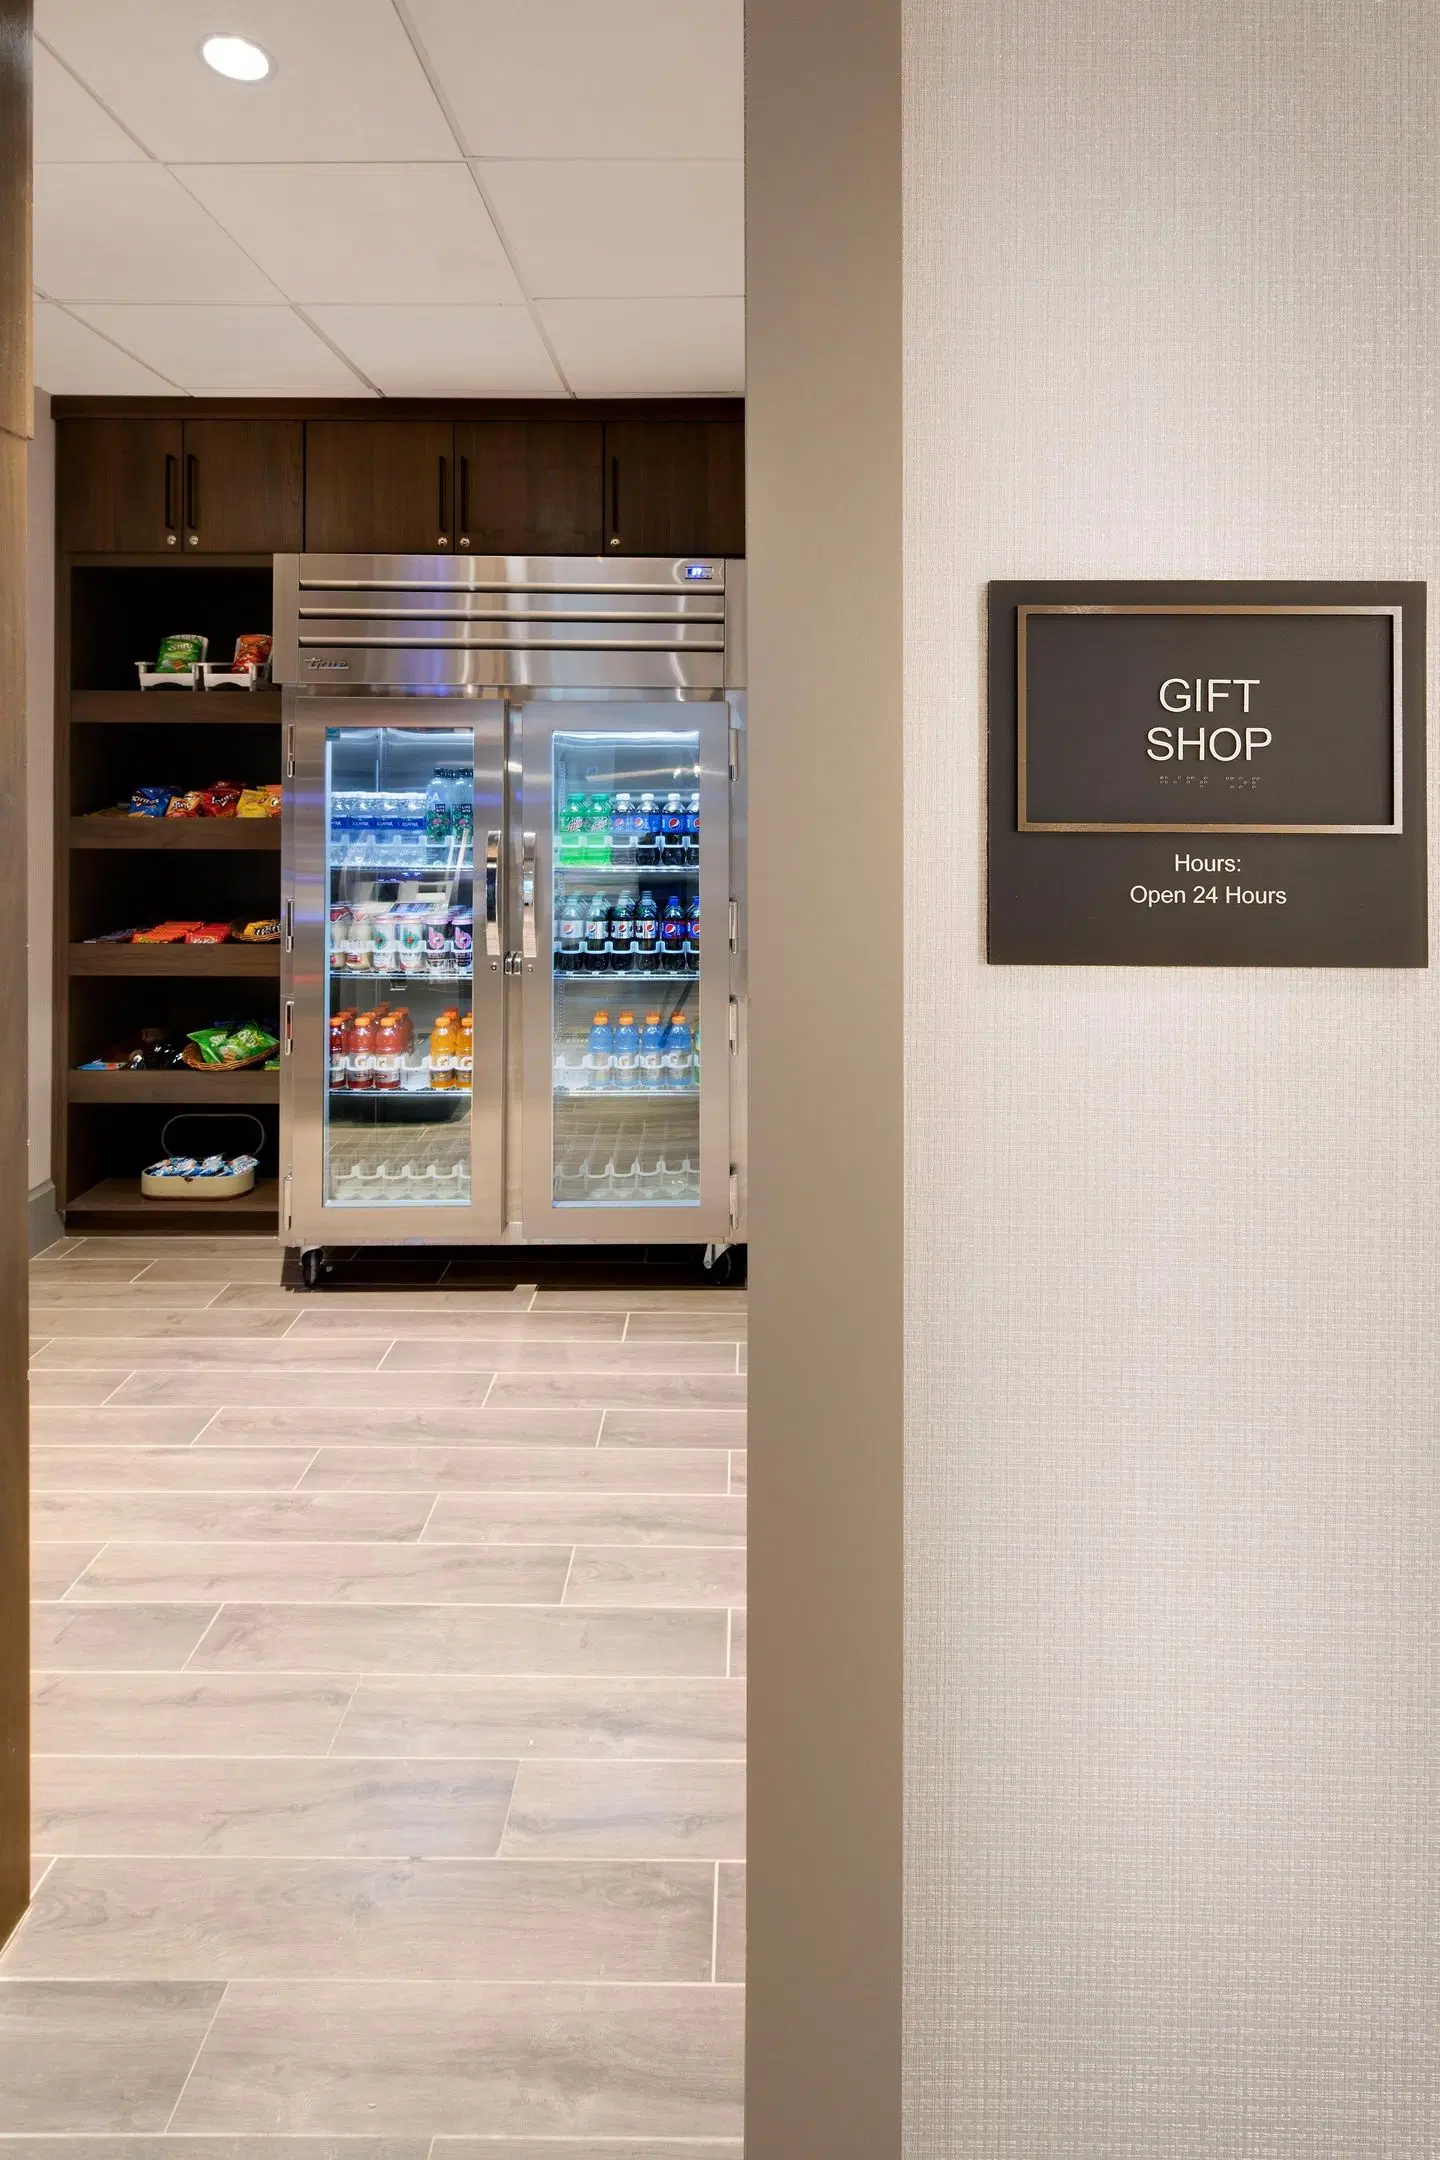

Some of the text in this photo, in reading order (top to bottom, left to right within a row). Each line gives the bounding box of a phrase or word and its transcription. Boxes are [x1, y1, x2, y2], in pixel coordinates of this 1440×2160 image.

[1159, 678, 1261, 713] GIFT
[1147, 726, 1272, 762] SHOP
[1174, 852, 1242, 874] Hours:
[1129, 885, 1288, 909] Open 24 Hours
